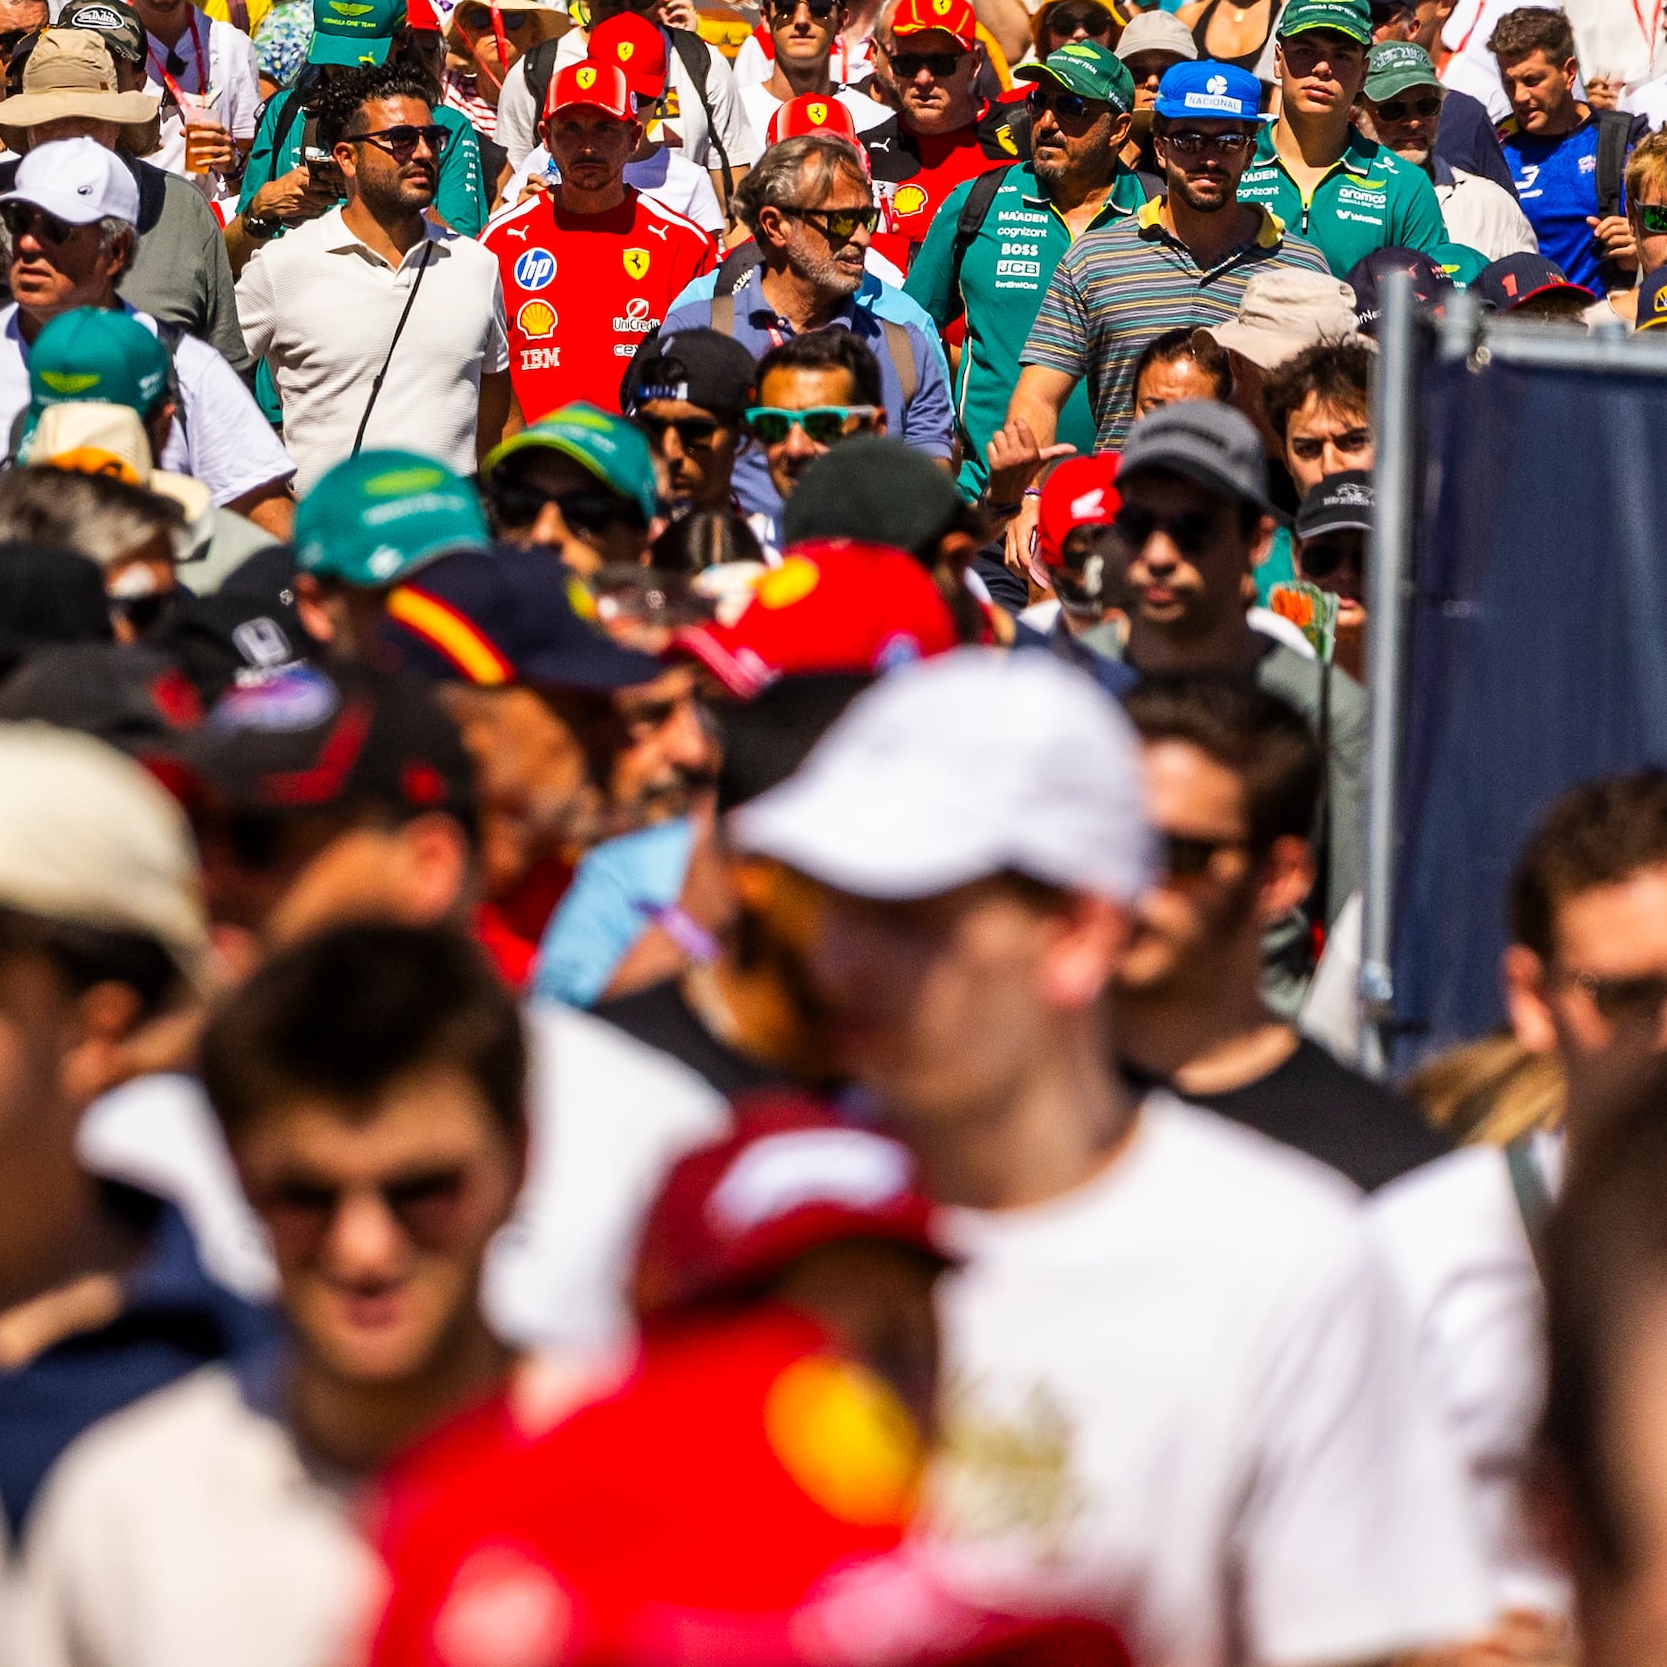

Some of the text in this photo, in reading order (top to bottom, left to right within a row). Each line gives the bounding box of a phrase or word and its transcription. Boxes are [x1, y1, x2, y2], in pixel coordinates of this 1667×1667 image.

[1185, 94, 1240, 111] NACIONAL
[1240, 169, 1278, 183] A'ADEN
[1236, 185, 1279, 198] ognizant
[1339, 188, 1387, 204] aramco
[997, 227, 1047, 239] cognizant
[1001, 242, 1039, 257] BOSS
[520, 250, 553, 288] hp
[998, 261, 1039, 275] JCB
[520, 346, 561, 372] IBM
